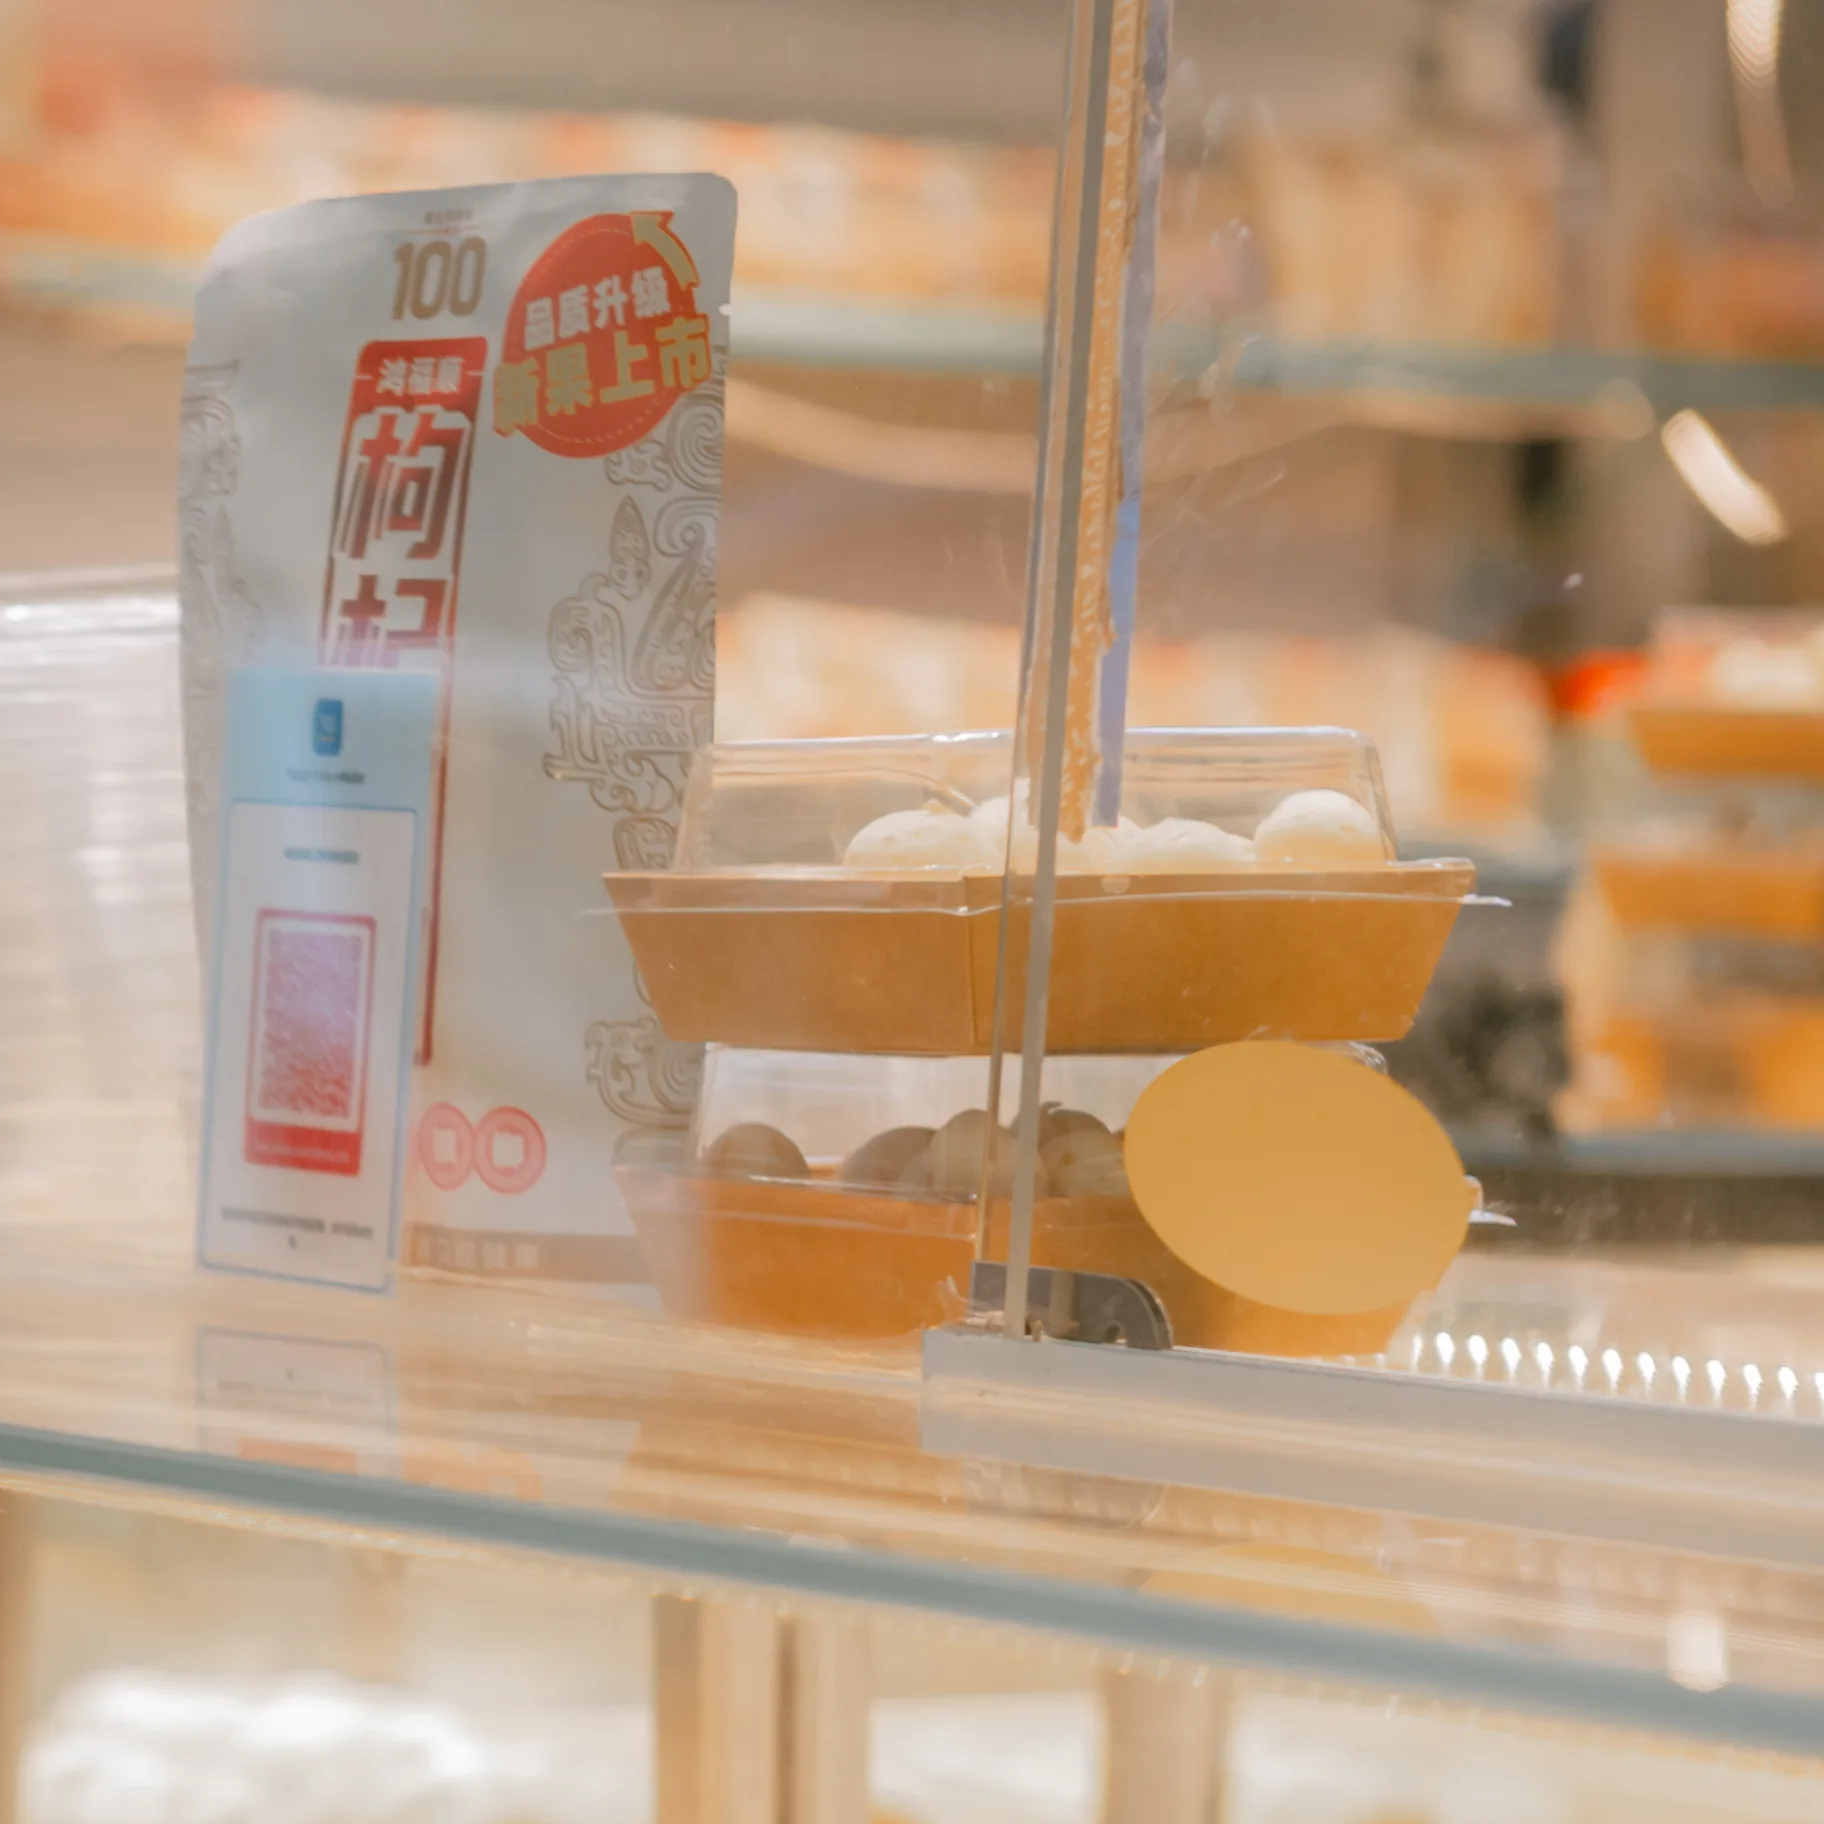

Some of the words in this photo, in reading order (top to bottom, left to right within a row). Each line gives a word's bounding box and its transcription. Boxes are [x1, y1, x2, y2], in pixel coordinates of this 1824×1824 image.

[392, 236, 486, 320] 100
[525, 267, 670, 350] 品质升级
